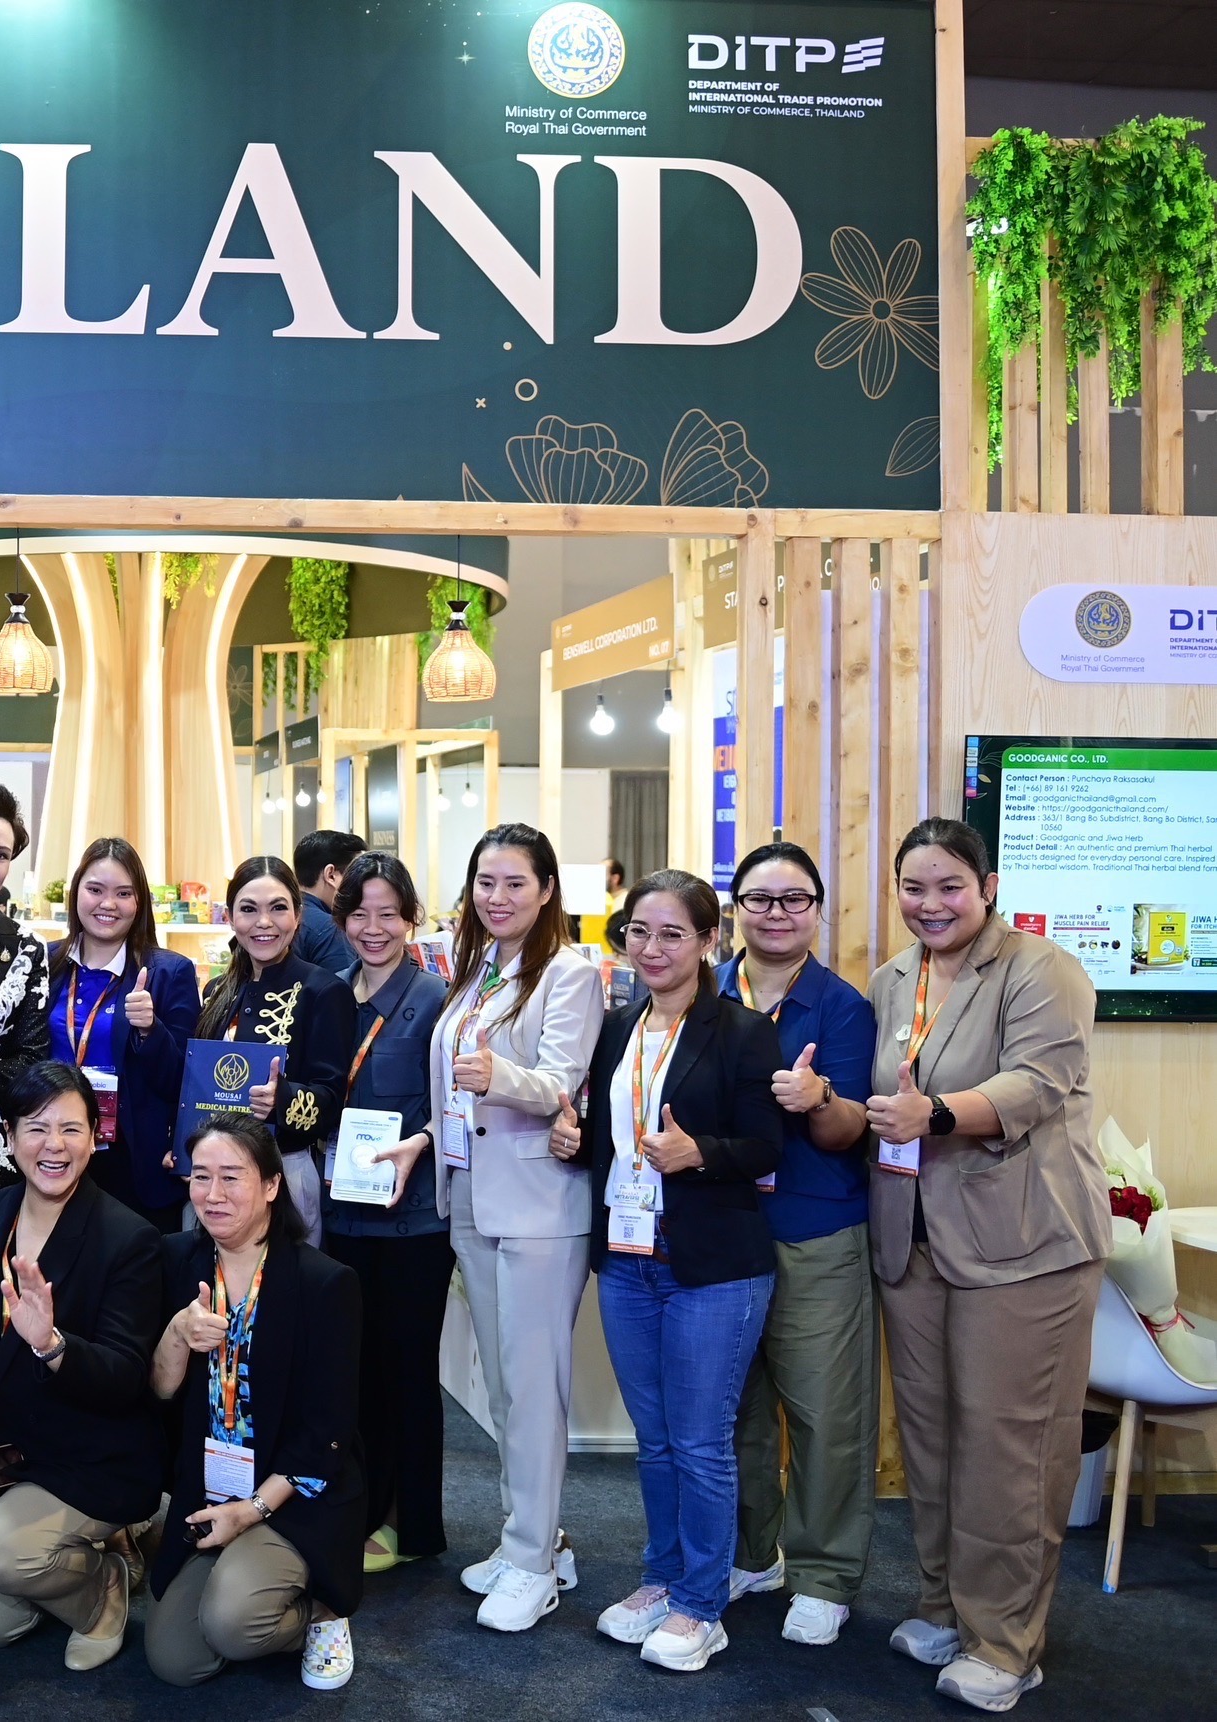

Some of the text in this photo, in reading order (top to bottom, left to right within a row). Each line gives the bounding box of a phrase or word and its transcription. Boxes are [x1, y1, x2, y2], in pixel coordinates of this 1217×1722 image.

[687, 33, 836, 74] DITP
[688, 79, 780, 91] DEPARTMENT OF
[688, 91, 883, 107] INTERNATIONAL TRADE PROMOTION
[505, 105, 647, 121] Ministry of Commerce
[688, 104, 865, 119] MINISTRY OF COMMERCE, THAILAND
[505, 121, 647, 137] Royal Thai Government
[563, 617, 658, 661] BENSWELL CORPORATION LTD.
[1061, 654, 1145, 663] Ministry of Commerce
[1061, 664, 1145, 673] Royal Thai Government
[1008, 753, 1109, 764] GOODGANIC CO., LTD.
[1005, 774, 1156, 784] Contact Person Punchaya Raksasakul
[1023, 784, 1042, 793] (+66)
[1032, 794, 1157, 804] goodganicthailand@gmail.com
[1041, 804, 1169, 814] https://goodganicthailand.com/
[1042, 814, 1063, 822] 363/1
[1065, 815, 1086, 823] Bang
[1099, 815, 1141, 823] Subdistrict,
[1143, 816, 1163, 824] Bang
[1177, 816, 1205, 824] District,
[1003, 833, 1034, 841] Product
[1040, 834, 1086, 842] Goodganic
[1105, 834, 1123, 842] Jiwa
[1003, 843, 1034, 851] Product
[1134, 845, 1169, 853] premium
[1002, 853, 1038, 862] products
[1038, 853, 1074, 862] designed
[1089, 855, 1127, 863] everyday
[1128, 855, 1162, 863] personal
[1185, 855, 1216, 863] Inspired
[1002, 863, 1013, 872] by
[1031, 863, 1057, 871] herbal
[1058, 863, 1091, 871] wisdom.
[1151, 864, 1177, 872] herbal
[1178, 864, 1201, 872] blend
[1191, 915, 1212, 923] JIWA
[213, 1091, 243, 1100] MOUSAI
[195, 1102, 255, 1114] MEDICAL RETRE
